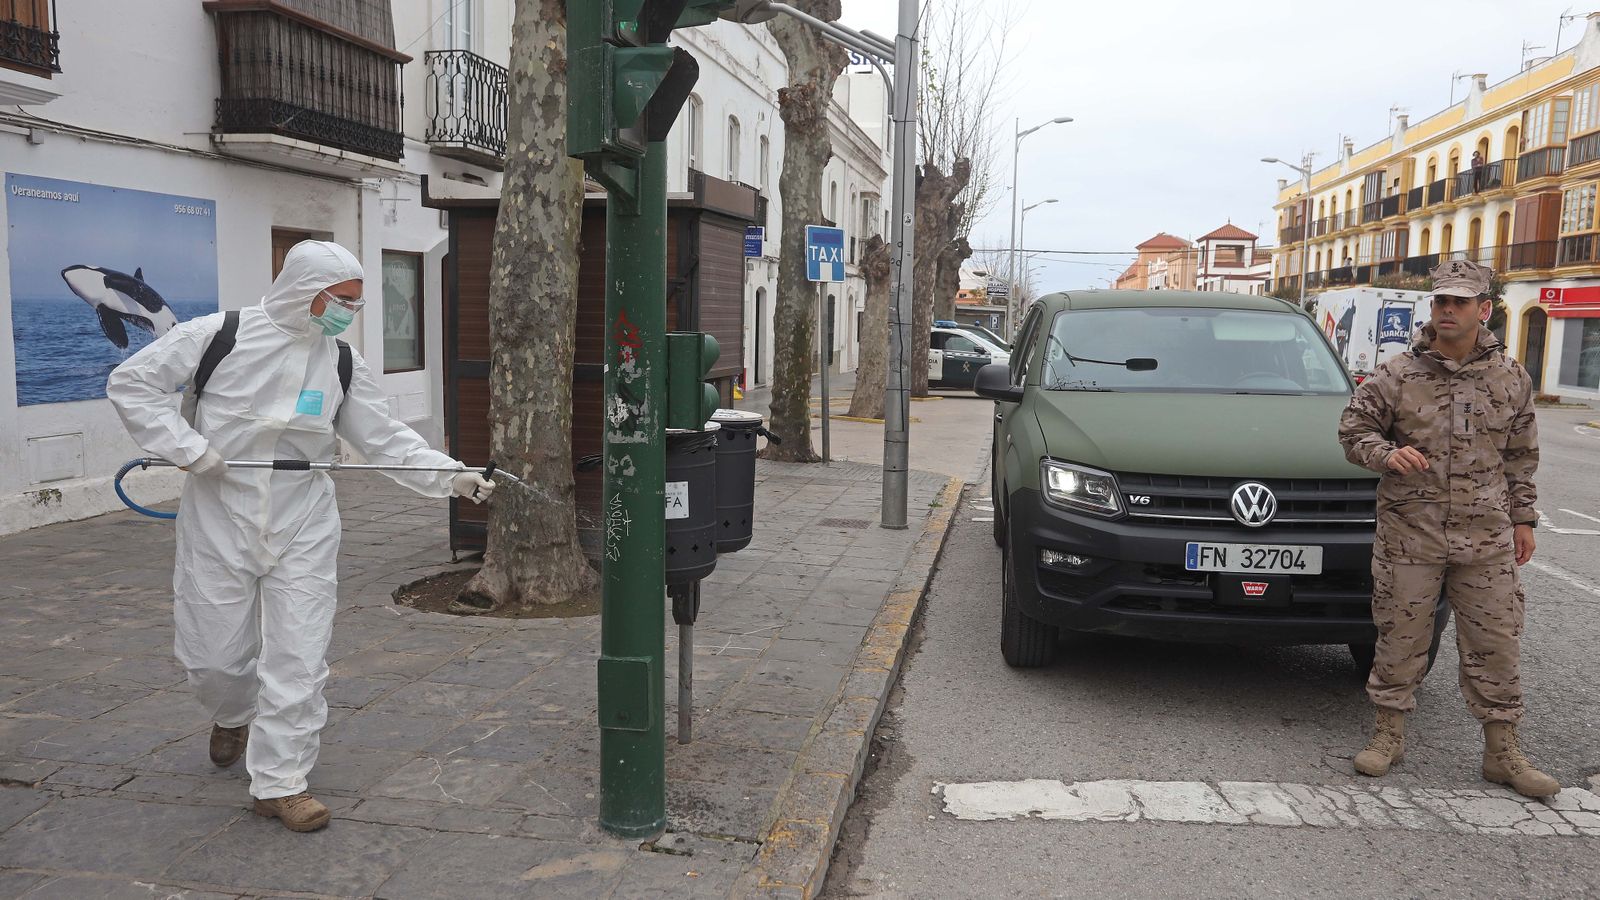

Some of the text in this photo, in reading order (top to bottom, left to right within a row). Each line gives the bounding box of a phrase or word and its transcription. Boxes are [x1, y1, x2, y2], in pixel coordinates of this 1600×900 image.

[11, 185, 62, 200] Veraneamos
[175, 204, 186, 214] 956
[187, 205, 195, 215] 68
[809, 245, 843, 263] TAXI
[1380, 329, 1410, 338] QUAKER
[666, 496, 683, 508] FA
[1129, 495, 1151, 505] V6
[1200, 547, 1306, 570] FN 32704
